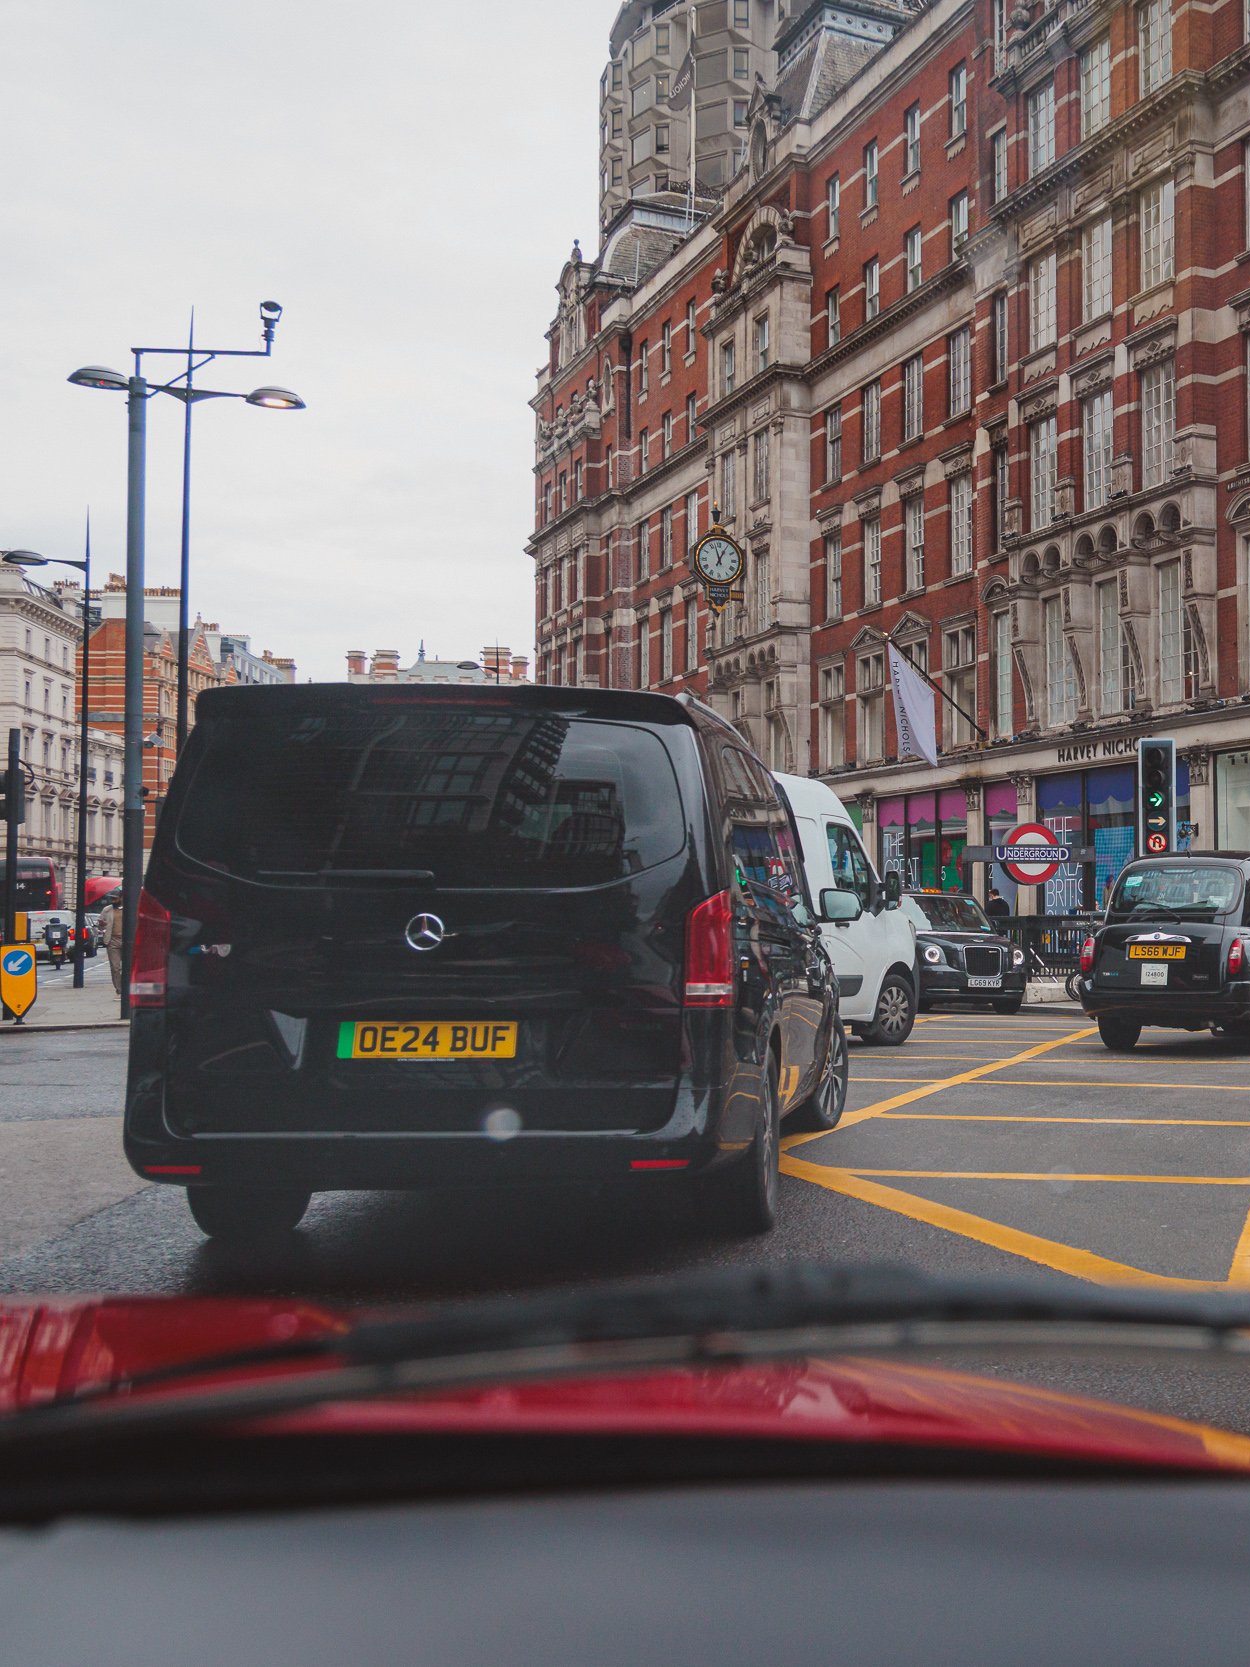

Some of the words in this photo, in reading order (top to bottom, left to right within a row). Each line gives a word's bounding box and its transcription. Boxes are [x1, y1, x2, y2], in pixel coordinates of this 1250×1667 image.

[900, 706, 911, 752] NICHOLS
[1057, 743, 1099, 762] HARVEY
[883, 832, 904, 857] THE
[995, 846, 1070, 861] UNDERGROUND
[1046, 878, 1084, 907] BRITIS
[1134, 946, 1159, 957] LS66
[1163, 946, 1182, 957] WJF
[970, 979, 986, 987] LG69
[987, 979, 1000, 987] KYR
[359, 1026, 440, 1053] OE24
[449, 1026, 510, 1053] BUF
